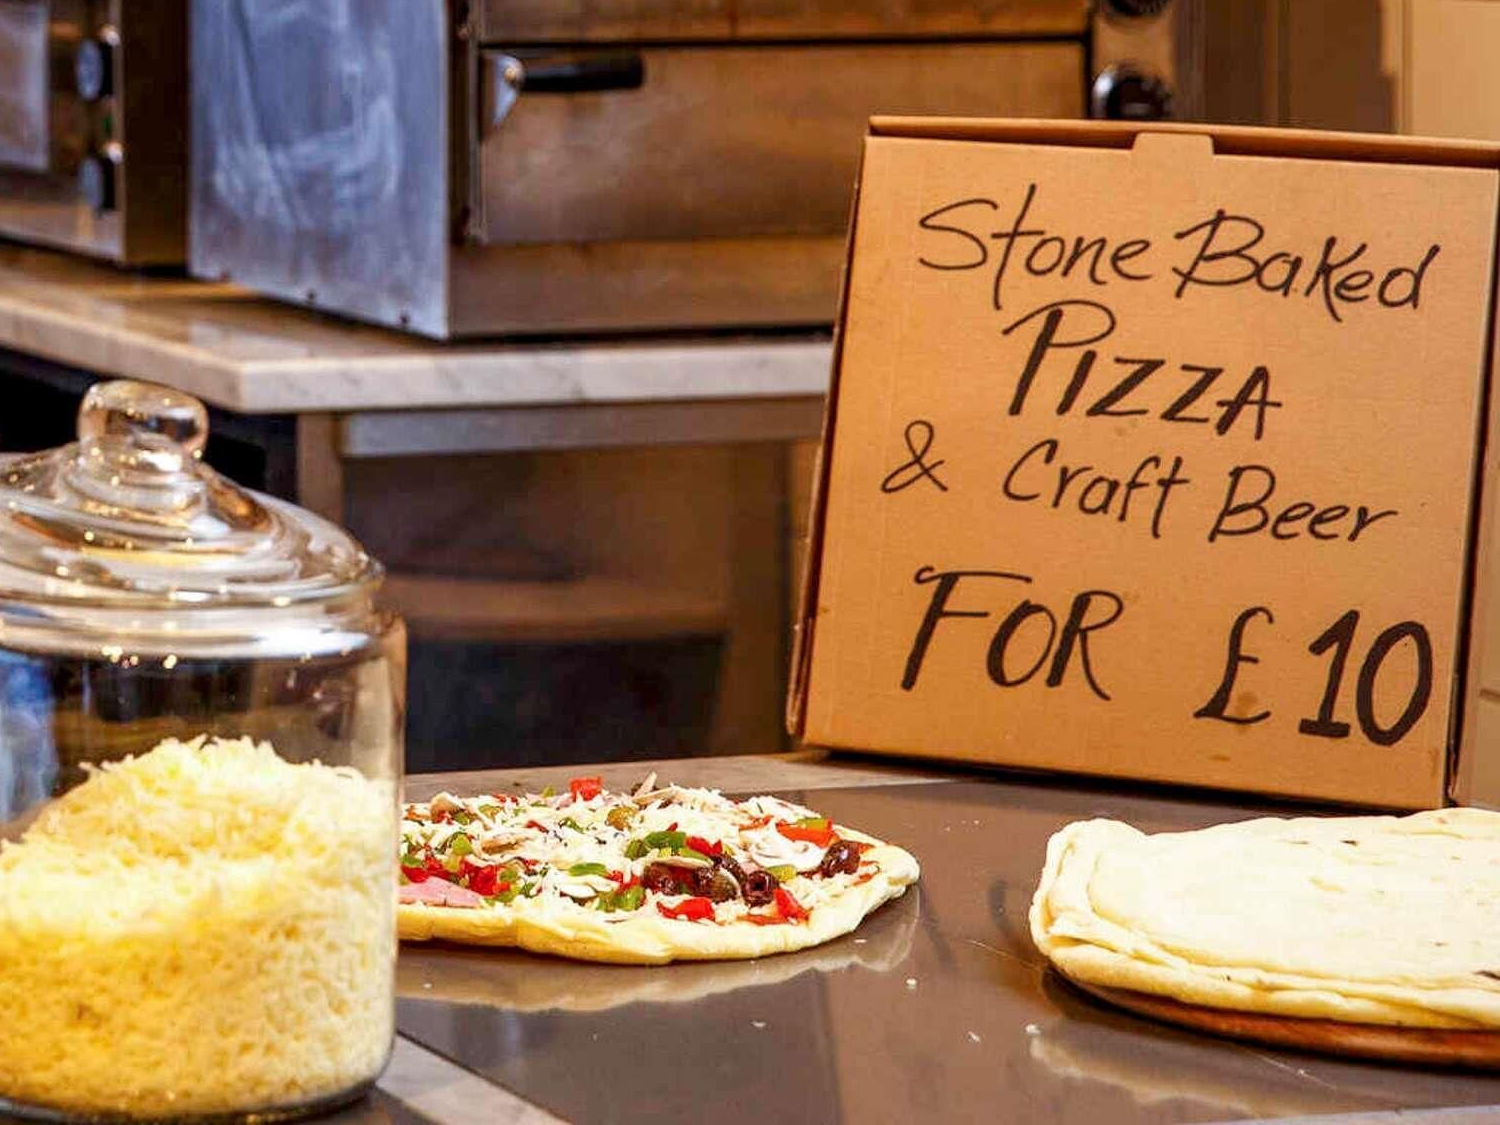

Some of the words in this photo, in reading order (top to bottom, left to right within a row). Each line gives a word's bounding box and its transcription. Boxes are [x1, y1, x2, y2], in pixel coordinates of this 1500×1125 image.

[918, 183, 1153, 311] Stone
[880, 419, 949, 495] &
[1002, 438, 1191, 540] Craft
[1208, 464, 1399, 543] Beer
[901, 565, 1124, 703] FOR
